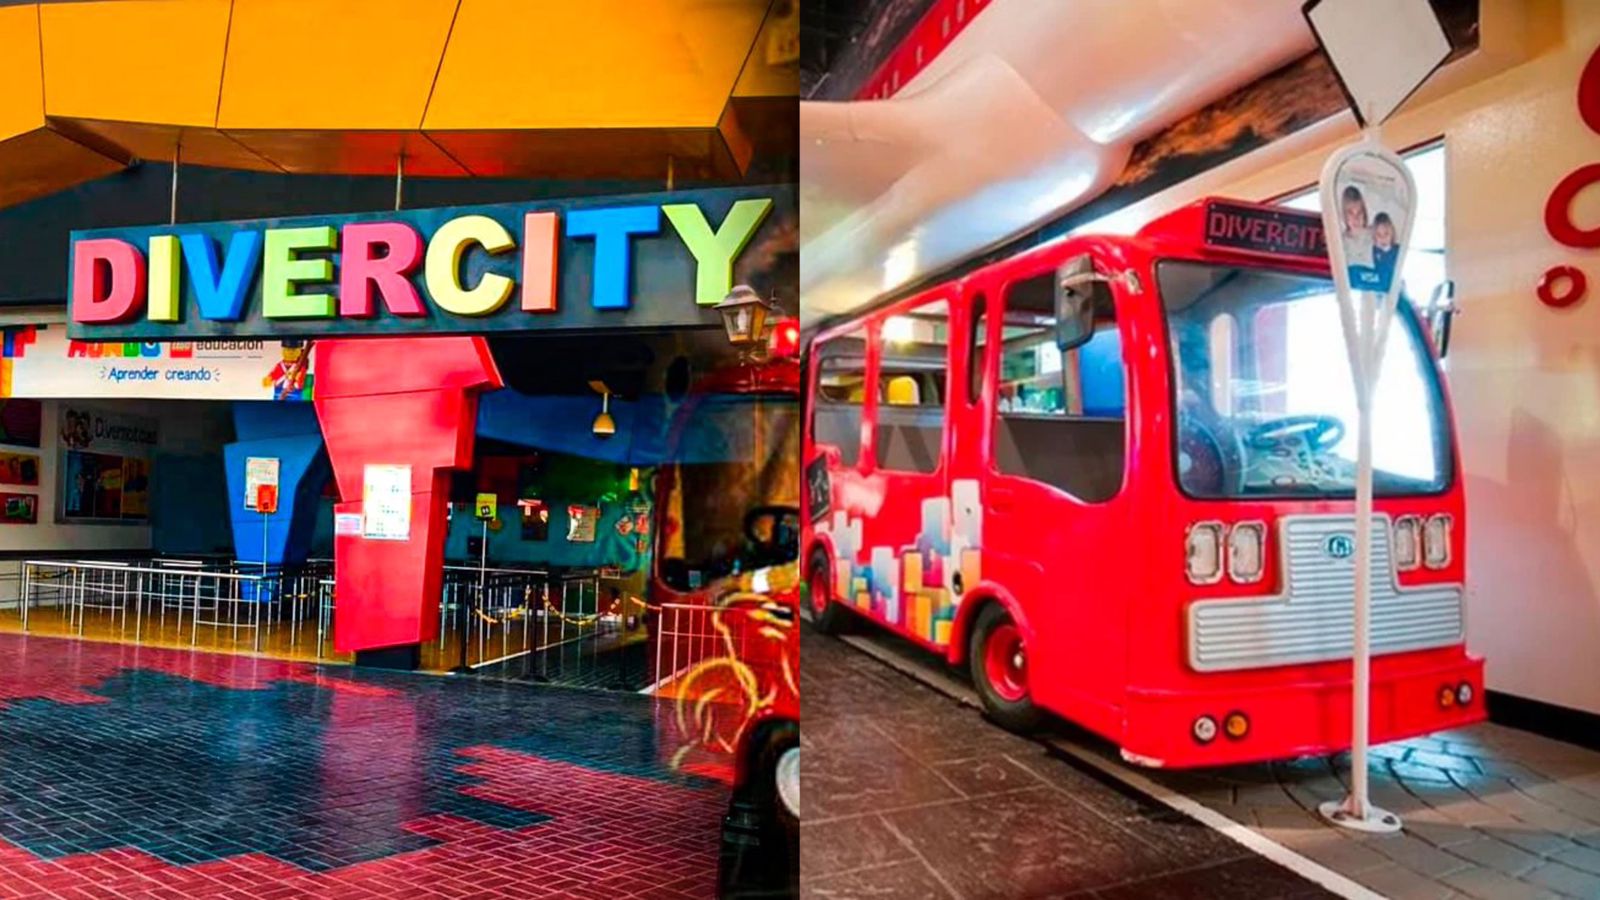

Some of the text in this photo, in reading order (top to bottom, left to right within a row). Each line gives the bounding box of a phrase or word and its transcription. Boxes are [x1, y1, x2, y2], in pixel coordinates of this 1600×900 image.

[72, 198, 772, 323] DIVERCITY
[108, 366, 212, 381] Aprender creando
